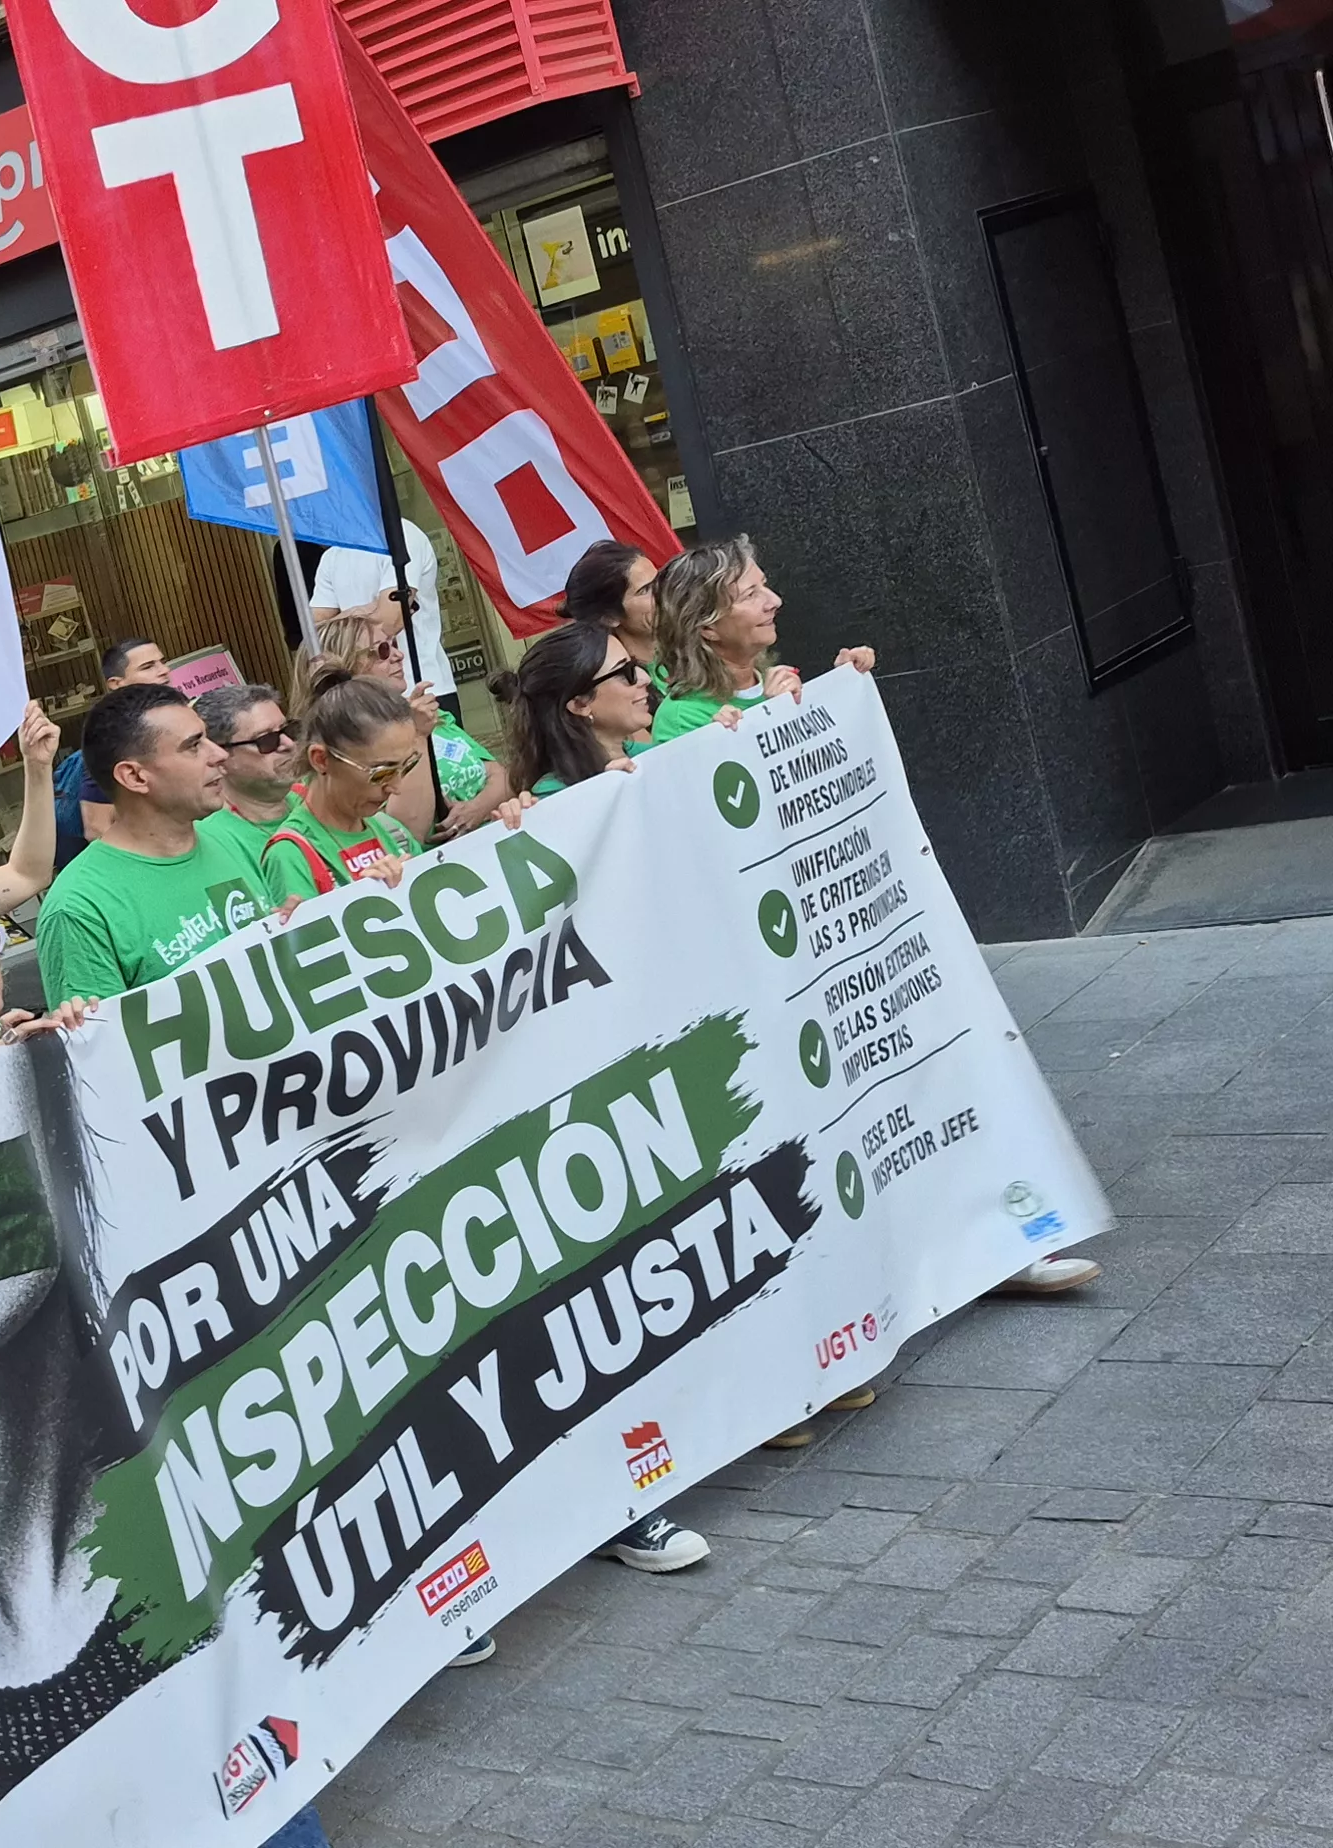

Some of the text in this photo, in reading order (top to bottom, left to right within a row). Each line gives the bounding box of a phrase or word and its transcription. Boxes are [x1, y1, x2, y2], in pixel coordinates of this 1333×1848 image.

[194, 665, 229, 687] Recuerdos
[756, 704, 837, 760] ELIMINAIÓN
[769, 737, 850, 795] DE MÍNIMOS
[777, 757, 878, 832] IMPRESCINDIBLES
[791, 825, 873, 889] UNIFICACIÓN
[800, 848, 893, 924] DE CRITERIOS EN
[807, 878, 909, 960] LAS 3 PROVINCIAS
[120, 830, 579, 1103] HUESCA
[824, 931, 932, 1017] REVISIÓN EXTERNA
[832, 964, 943, 1053] DE LAS SANCIONES
[140, 914, 614, 1201] Y PROVINCIA
[842, 1025, 914, 1088] IMPUESTAS
[861, 1102, 916, 1161] CESE DEL
[871, 1106, 981, 1196] INSPECTOR JEFE
[108, 1155, 359, 1432] POR UNA
[156, 1068, 703, 1601] INSPECCIÓN
[814, 1321, 859, 1370] UGT
[280, 1189, 797, 1632] ÚTIL Y JUSTA
[630, 1443, 672, 1482] STEA
[422, 1559, 469, 1608] CCOO
[440, 1574, 499, 1628] enseñanza
